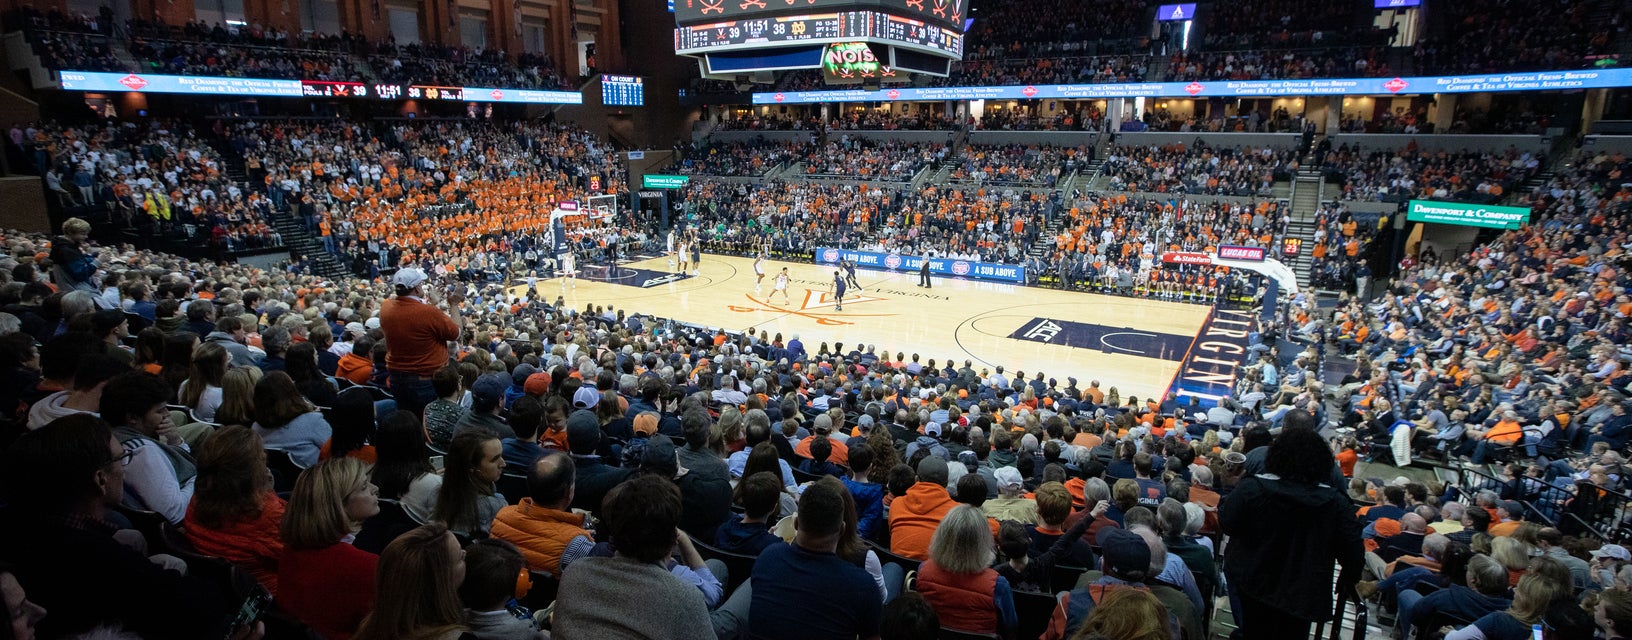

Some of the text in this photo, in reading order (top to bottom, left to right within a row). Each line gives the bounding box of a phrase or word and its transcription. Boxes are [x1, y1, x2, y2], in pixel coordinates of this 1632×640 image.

[743, 20, 768, 33] 11:51
[773, 23, 785, 35] 38
[927, 25, 939, 38] 11:51
[729, 27, 740, 38] 39
[918, 28, 926, 39] 39
[1541, 79, 1583, 87] ATHLETICS
[353, 86, 366, 96] 39
[375, 84, 401, 95] 11:51
[408, 88, 420, 97] 38
[1414, 204, 1465, 216] DAVENPORT
[1476, 209, 1523, 221] COMPANY
[1222, 249, 1247, 257] LUCAS
[906, 259, 910, 267] A
[981, 266, 993, 275] SUB
[1024, 320, 1062, 342] ACC
[1176, 308, 1254, 401] VIRGINI
